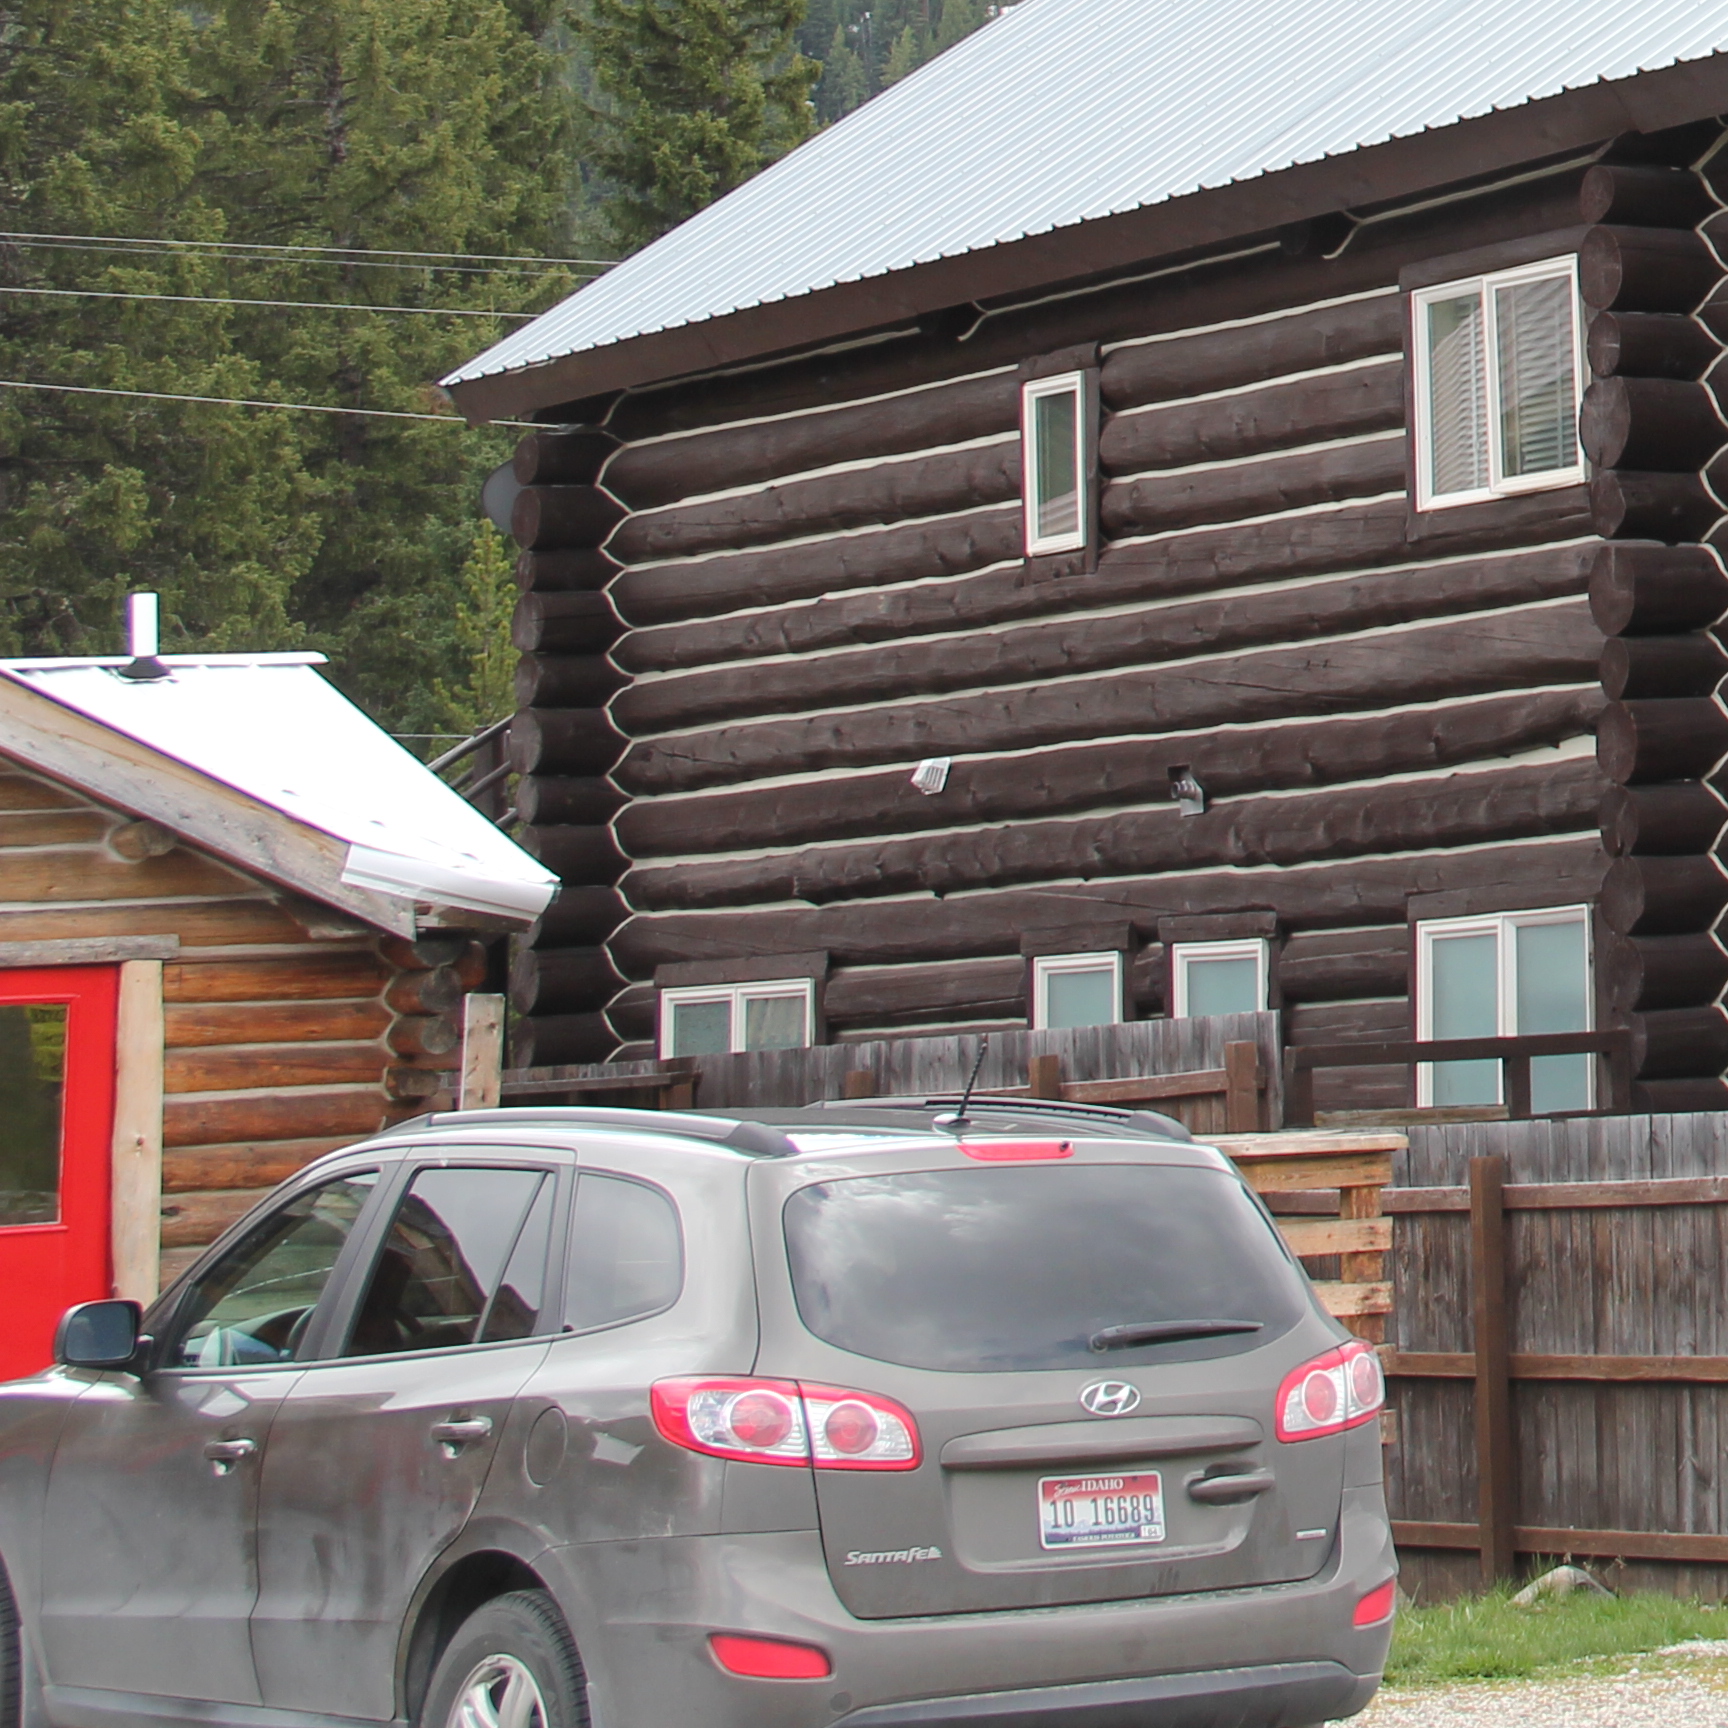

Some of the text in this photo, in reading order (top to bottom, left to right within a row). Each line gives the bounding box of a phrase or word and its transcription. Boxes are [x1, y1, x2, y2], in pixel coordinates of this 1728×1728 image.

[1081, 1478, 1124, 1492] IDAHO
[1050, 1493, 1155, 1529] 10 16689
